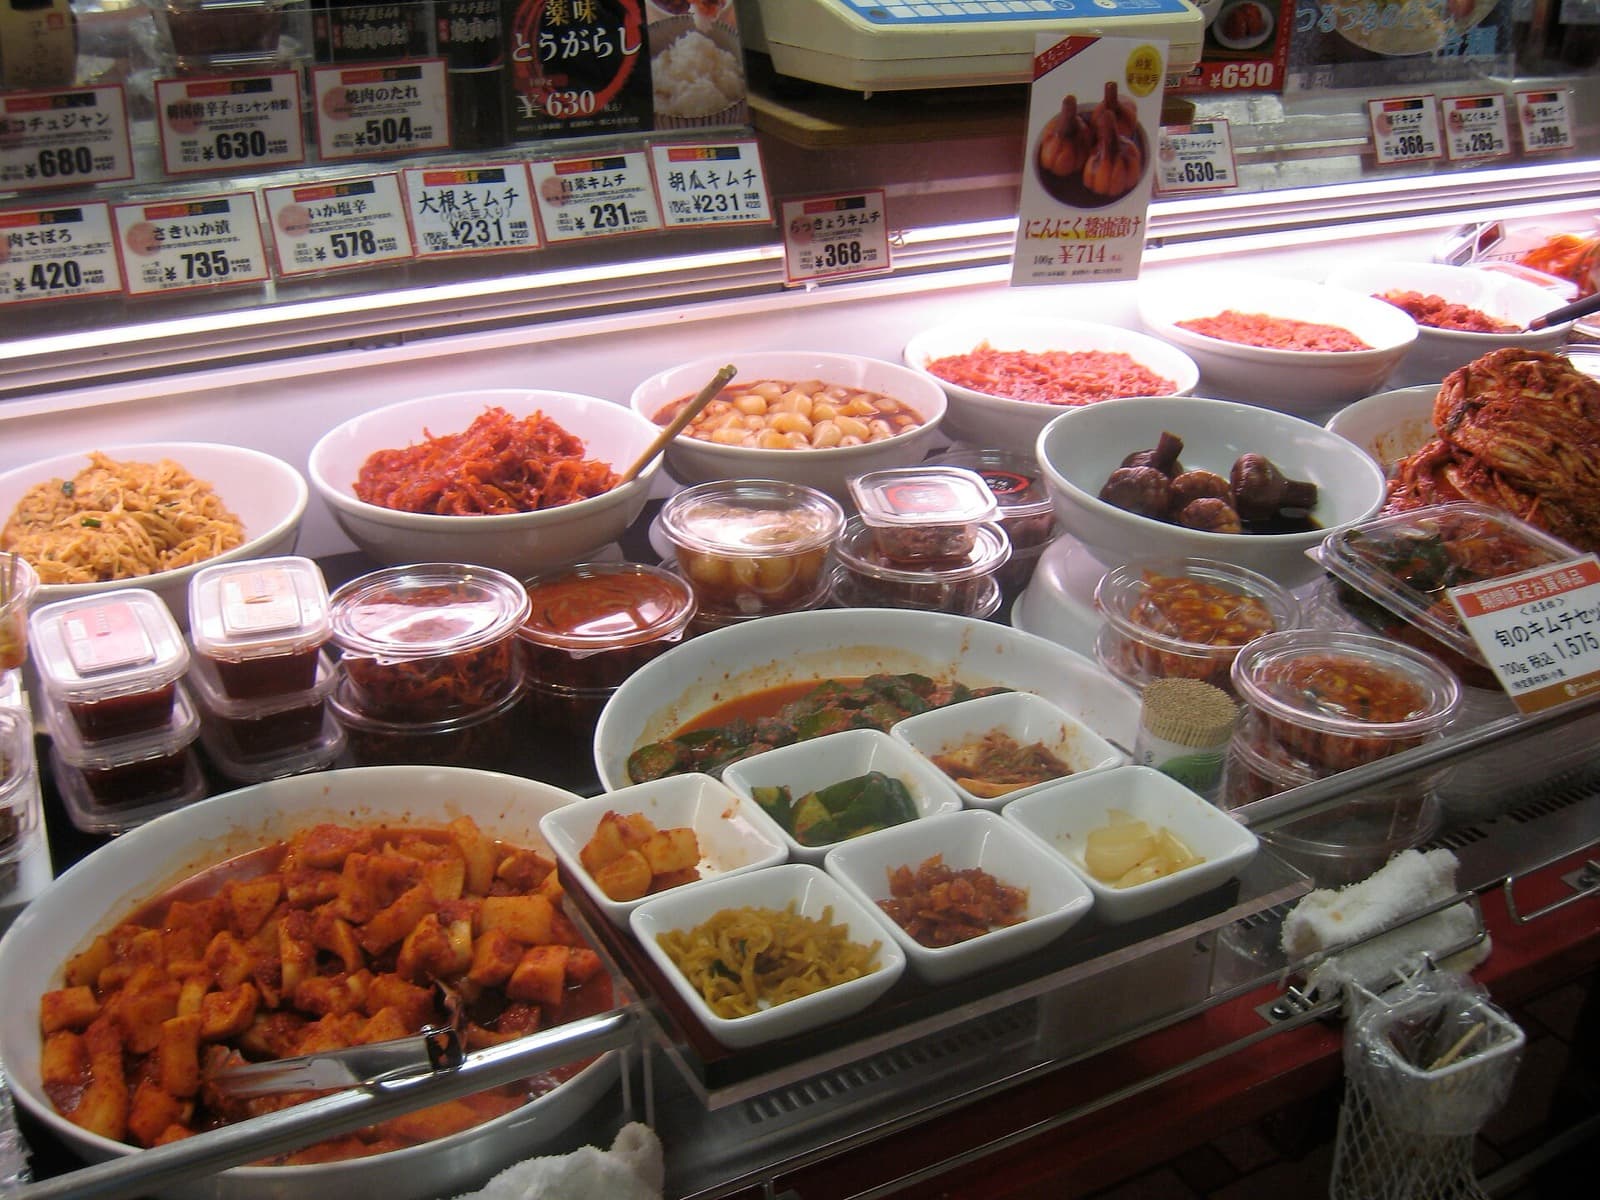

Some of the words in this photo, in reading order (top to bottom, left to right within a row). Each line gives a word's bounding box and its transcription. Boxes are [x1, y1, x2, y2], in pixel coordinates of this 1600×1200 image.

[545, 0, 598, 26] 薬味
[512, 27, 643, 62] とうがらし
[1209, 62, 1274, 88] ¥630
[344, 85, 419, 104] 焼肉のたれ
[516, 90, 595, 119] ¥630
[355, 116, 413, 147] ¥504
[203, 131, 266, 161] ¥630
[25, 146, 93, 178] ¥680
[1178, 161, 1215, 182] ¥630
[561, 173, 627, 192] 白菜キムチ
[668, 168, 757, 192] 胡瓜キムチ
[418, 187, 519, 214] 大根キムチ
[692, 193, 739, 213] ¥231
[153, 219, 231, 241] さきいか漬
[574, 202, 630, 231] ¥231
[1024, 215, 1142, 240] にんにく醤油漬け
[315, 229, 377, 261] ¥578
[450, 219, 504, 244] ¥231
[165, 250, 230, 281] ¥735
[815, 241, 862, 268] ¥368
[1059, 244, 1106, 265] ¥714
[14, 260, 82, 292] ¥420
[1475, 570, 1587, 609] 期間限定お買得品
[1495, 601, 1600, 648] 旬のキムチセッ
[1553, 631, 1600, 660] 1,575
